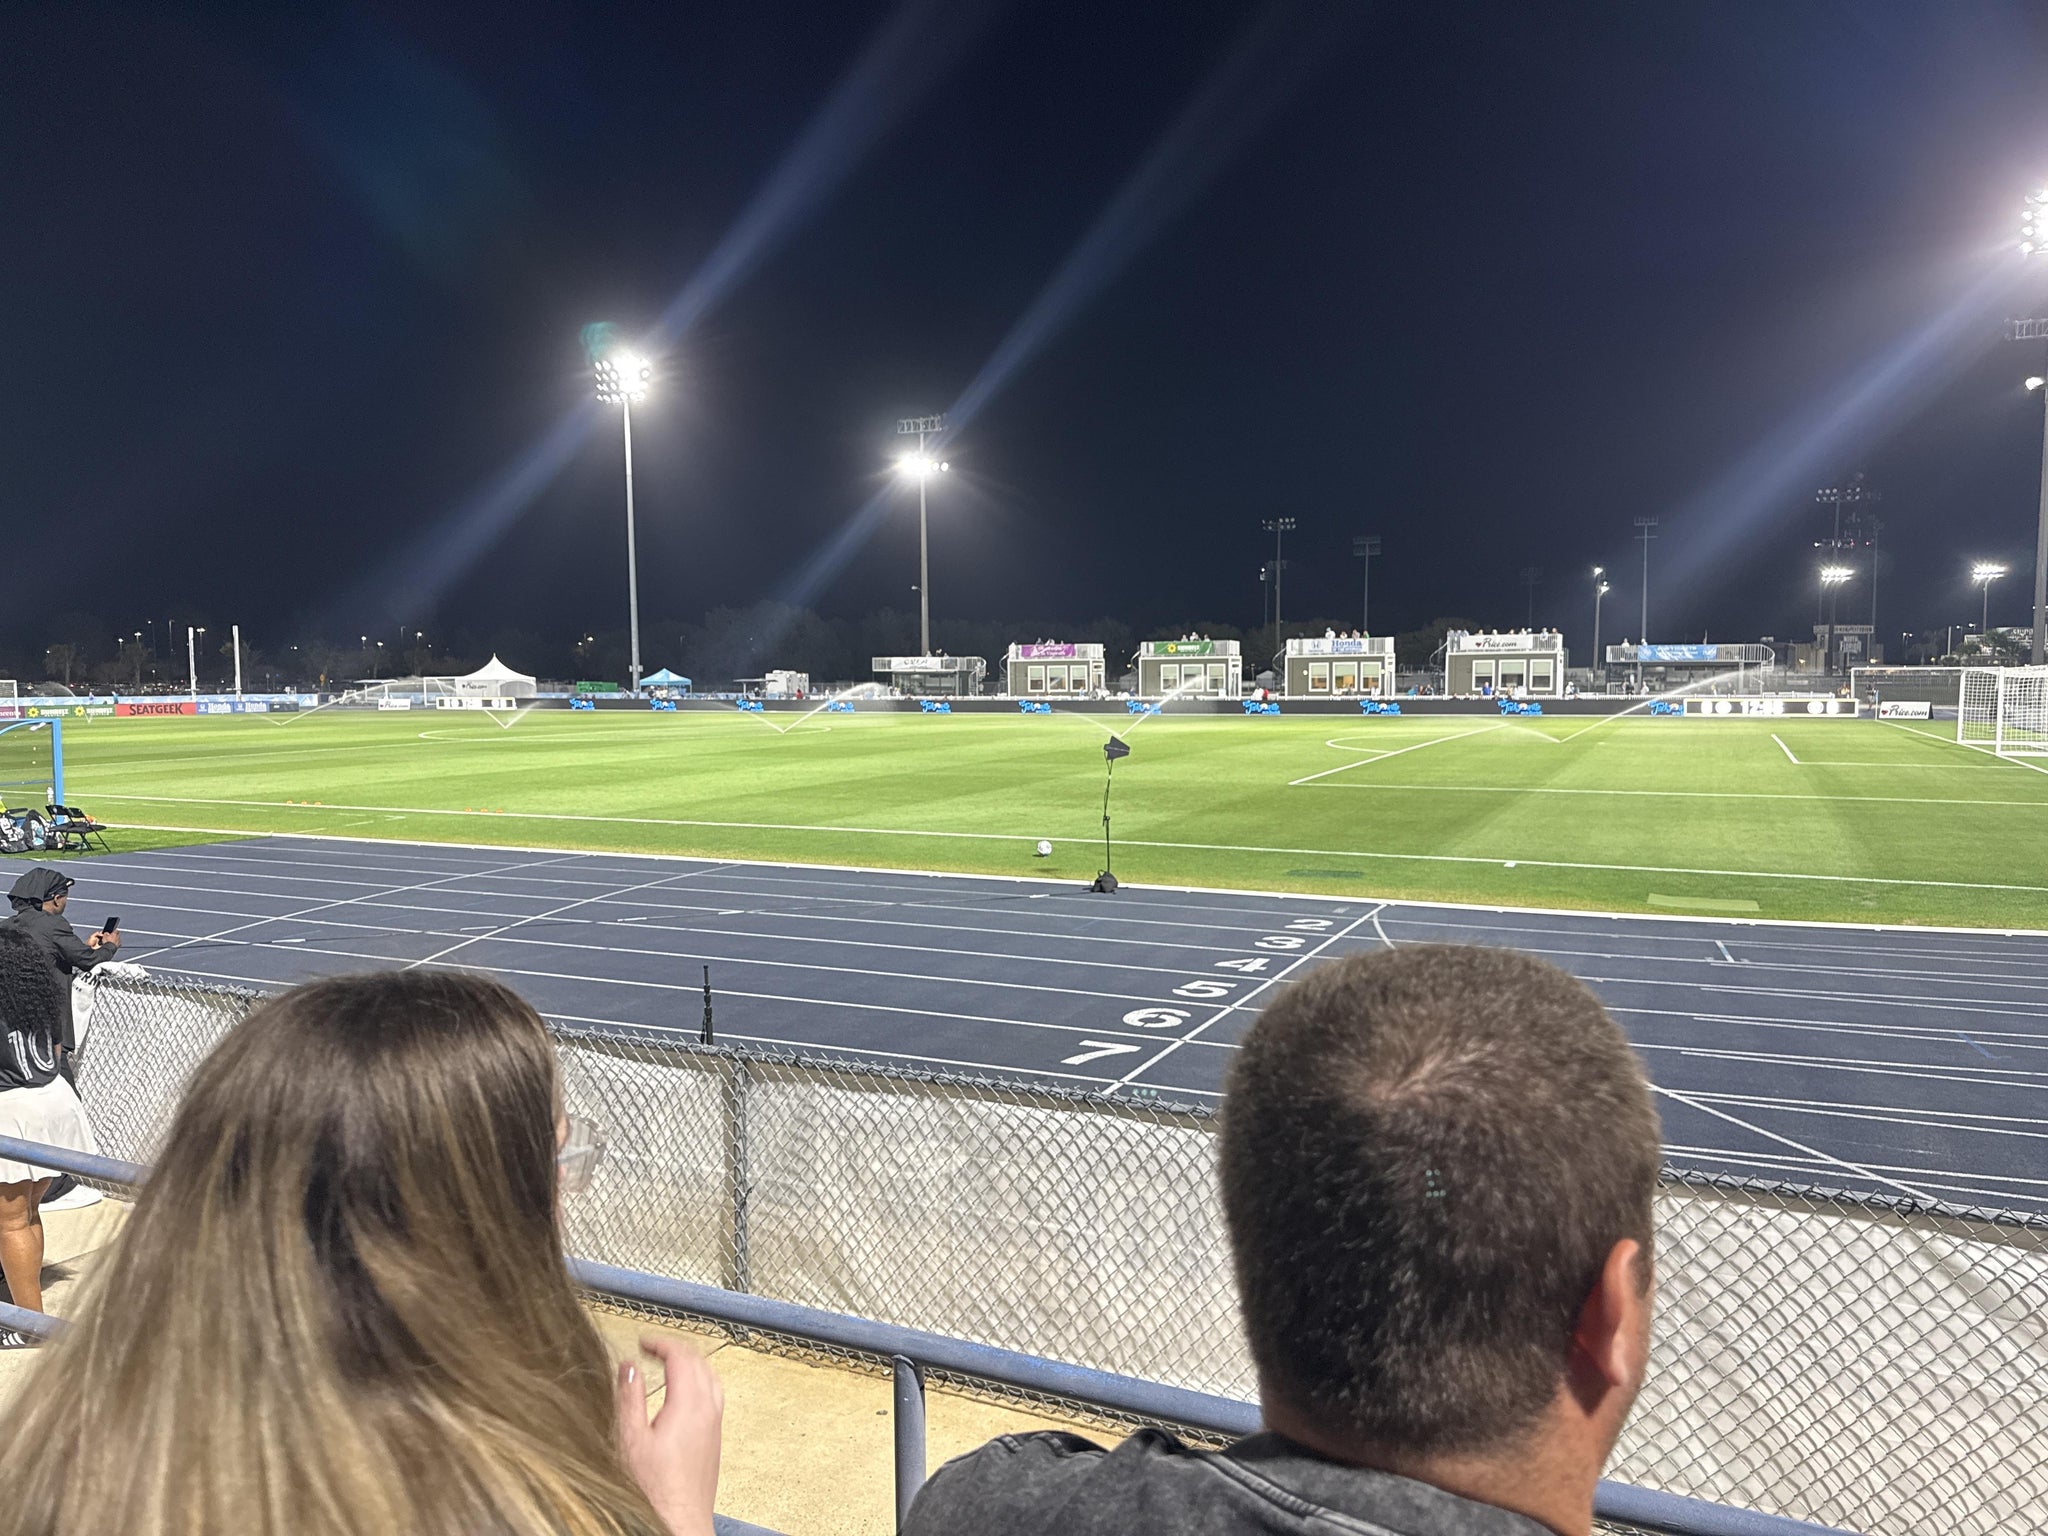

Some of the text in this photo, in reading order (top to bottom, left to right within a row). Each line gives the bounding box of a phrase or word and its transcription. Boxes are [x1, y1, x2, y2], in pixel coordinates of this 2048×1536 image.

[1331, 640, 1362, 648] Honda
[1482, 637, 1517, 648] Price.com
[129, 703, 183, 715] SEATGEEK
[1889, 704, 1928, 716] Price.com
[1285, 919, 1333, 930] 2
[1254, 936, 1305, 949] 3
[1214, 957, 1270, 972] 4
[1172, 980, 1238, 998] 5
[1122, 1008, 1191, 1028] 6
[7, 1028, 55, 1080] 10
[1060, 1039, 1142, 1065] 7
